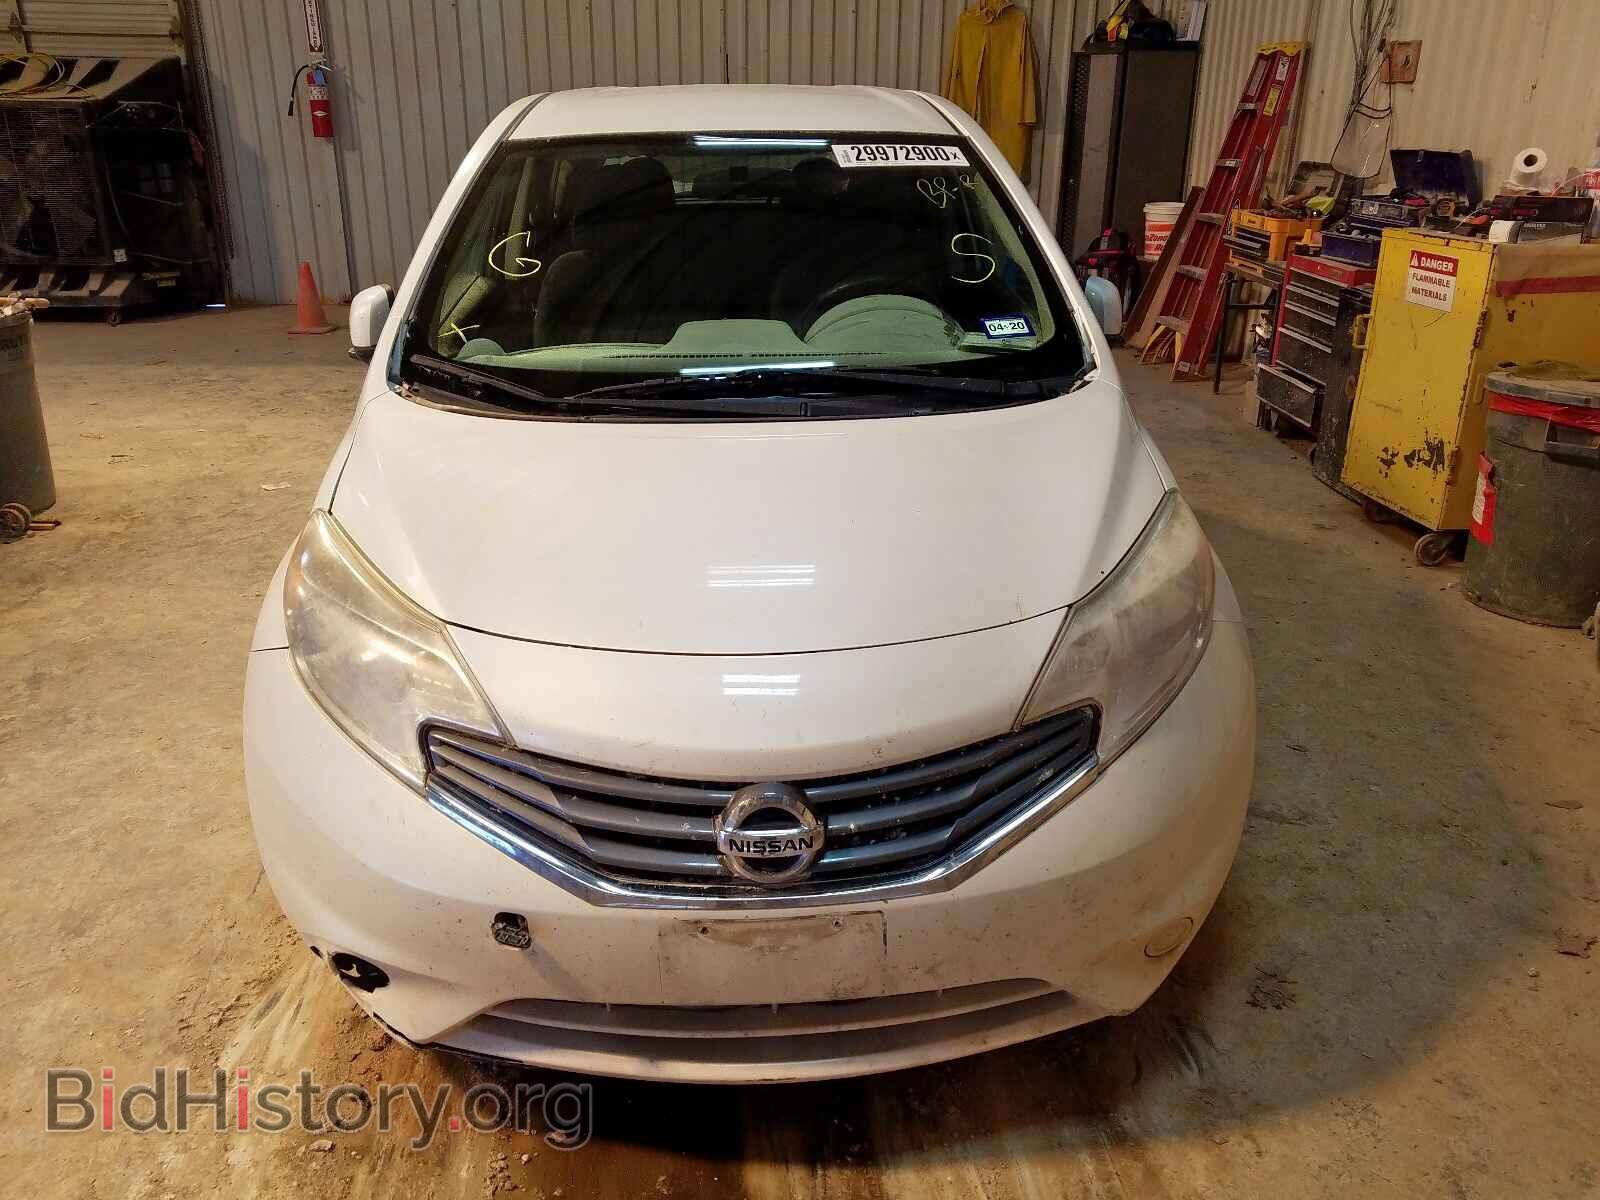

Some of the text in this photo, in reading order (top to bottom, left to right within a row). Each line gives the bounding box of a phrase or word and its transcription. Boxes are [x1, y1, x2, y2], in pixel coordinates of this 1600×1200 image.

[851, 145, 951, 161] 29972900
[488, 230, 541, 277] G
[951, 232, 995, 283] S
[1420, 257, 1454, 272] DANGER
[1412, 273, 1451, 288] FLAMMABLE
[1411, 287, 1447, 301] MATERIALS
[728, 836, 814, 853] NISSAN
